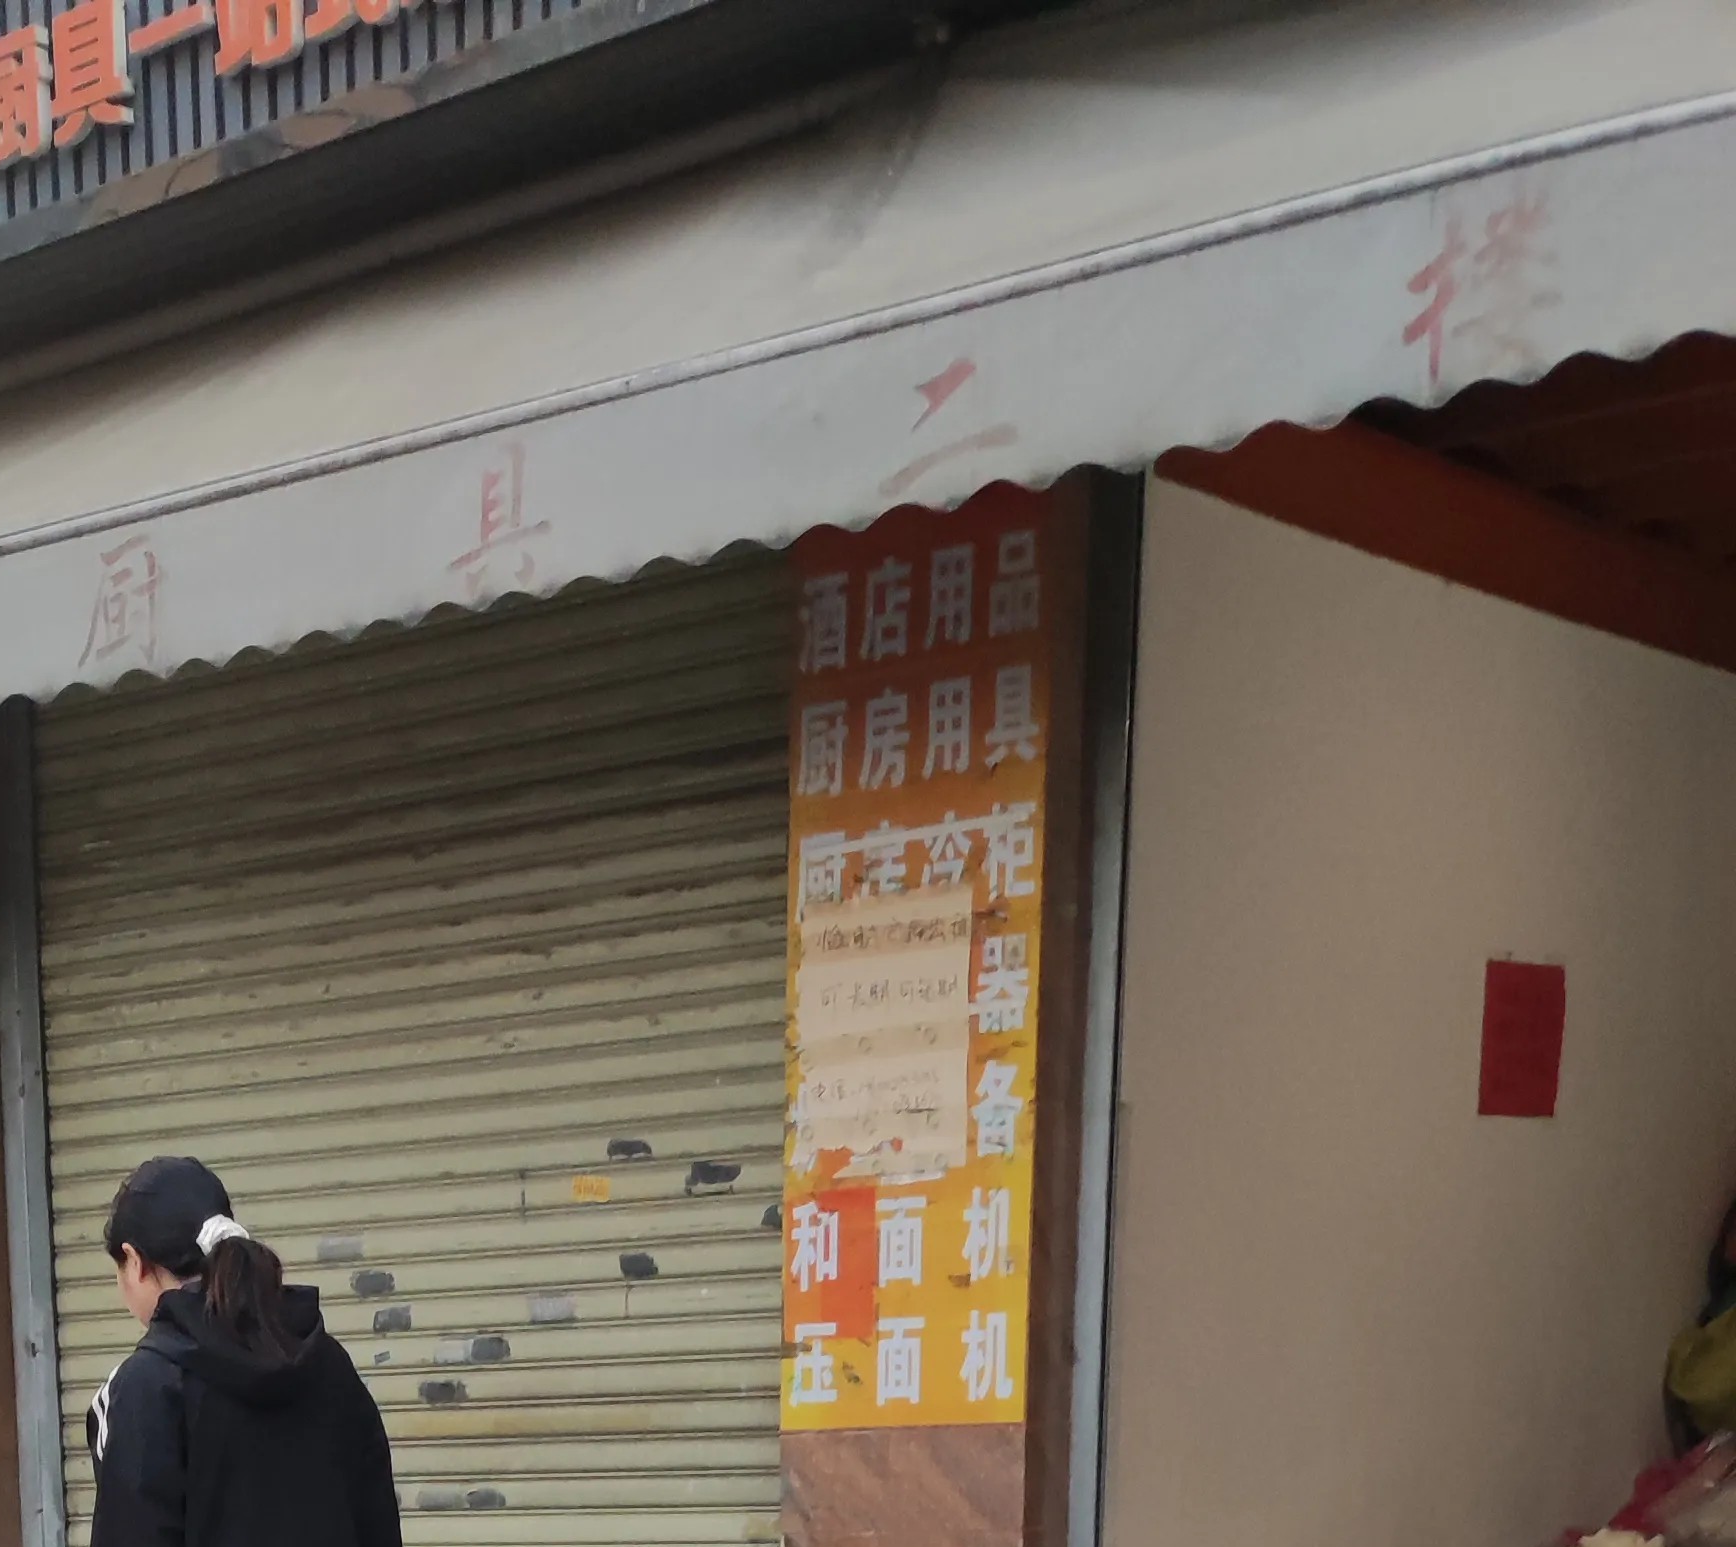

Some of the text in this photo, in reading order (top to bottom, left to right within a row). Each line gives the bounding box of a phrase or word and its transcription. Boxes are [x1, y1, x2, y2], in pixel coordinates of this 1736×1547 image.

[799, 530, 1040, 673] 酒店用品
[798, 664, 1039, 796] 厨房用具
[790, 1186, 1015, 1292] 和面机
[789, 1309, 1014, 1407] 压面机
